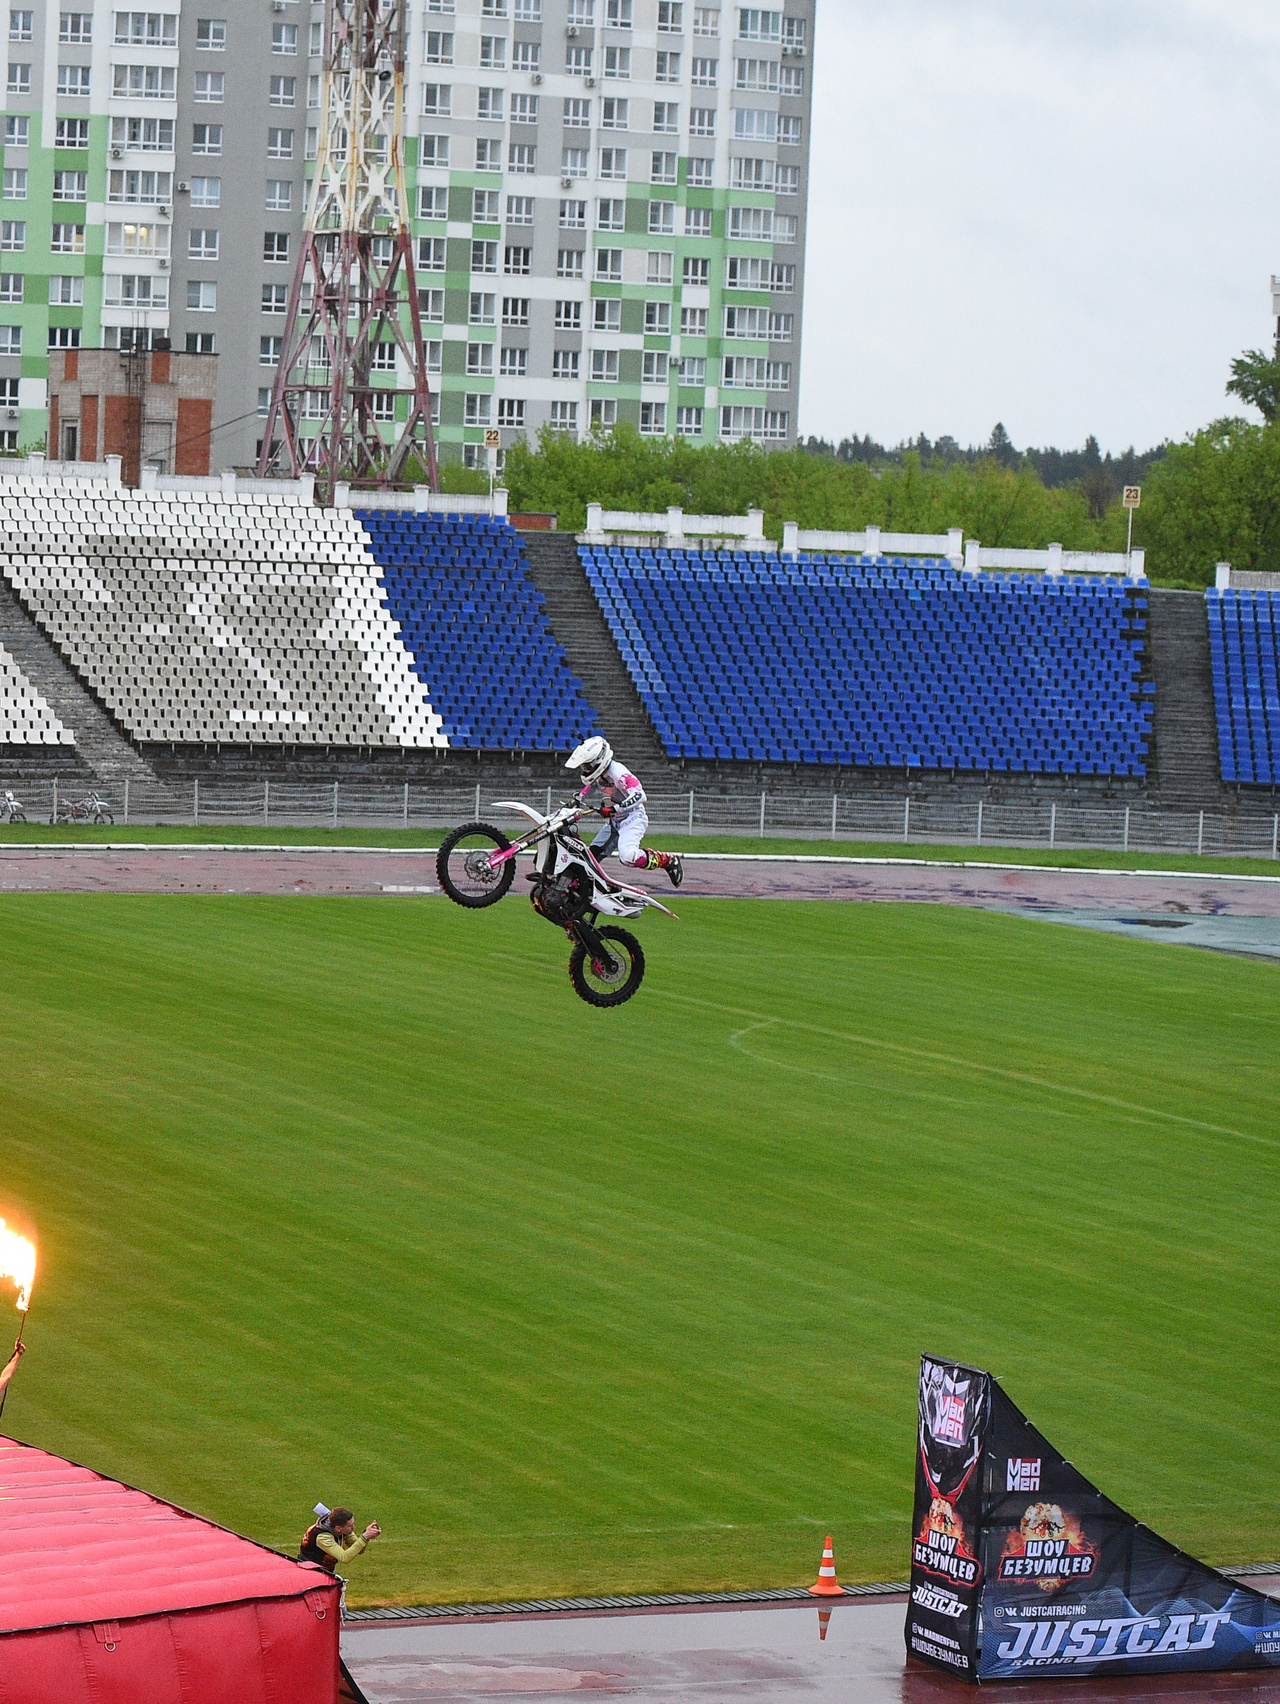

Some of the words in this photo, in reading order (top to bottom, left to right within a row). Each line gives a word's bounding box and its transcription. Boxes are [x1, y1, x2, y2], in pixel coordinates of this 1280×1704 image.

[486, 430, 499, 441] 22
[1125, 488, 1138, 499] 23
[1007, 1458, 1041, 1477] Mad
[1006, 1475, 1040, 1491] Men
[928, 1530, 956, 1555] ШОУ
[1026, 1540, 1065, 1557] ШОУ
[915, 1544, 976, 1580] БЕЗУМЦЕВ
[1004, 1556, 1092, 1576] БЕЗУМЦЕВ
[912, 1585, 968, 1617] JUSTCAT
[1020, 1605, 1087, 1617] JUSTCATRACING
[996, 1612, 1232, 1659] JUSTCAT
[1011, 1657, 1075, 1666] RACING
